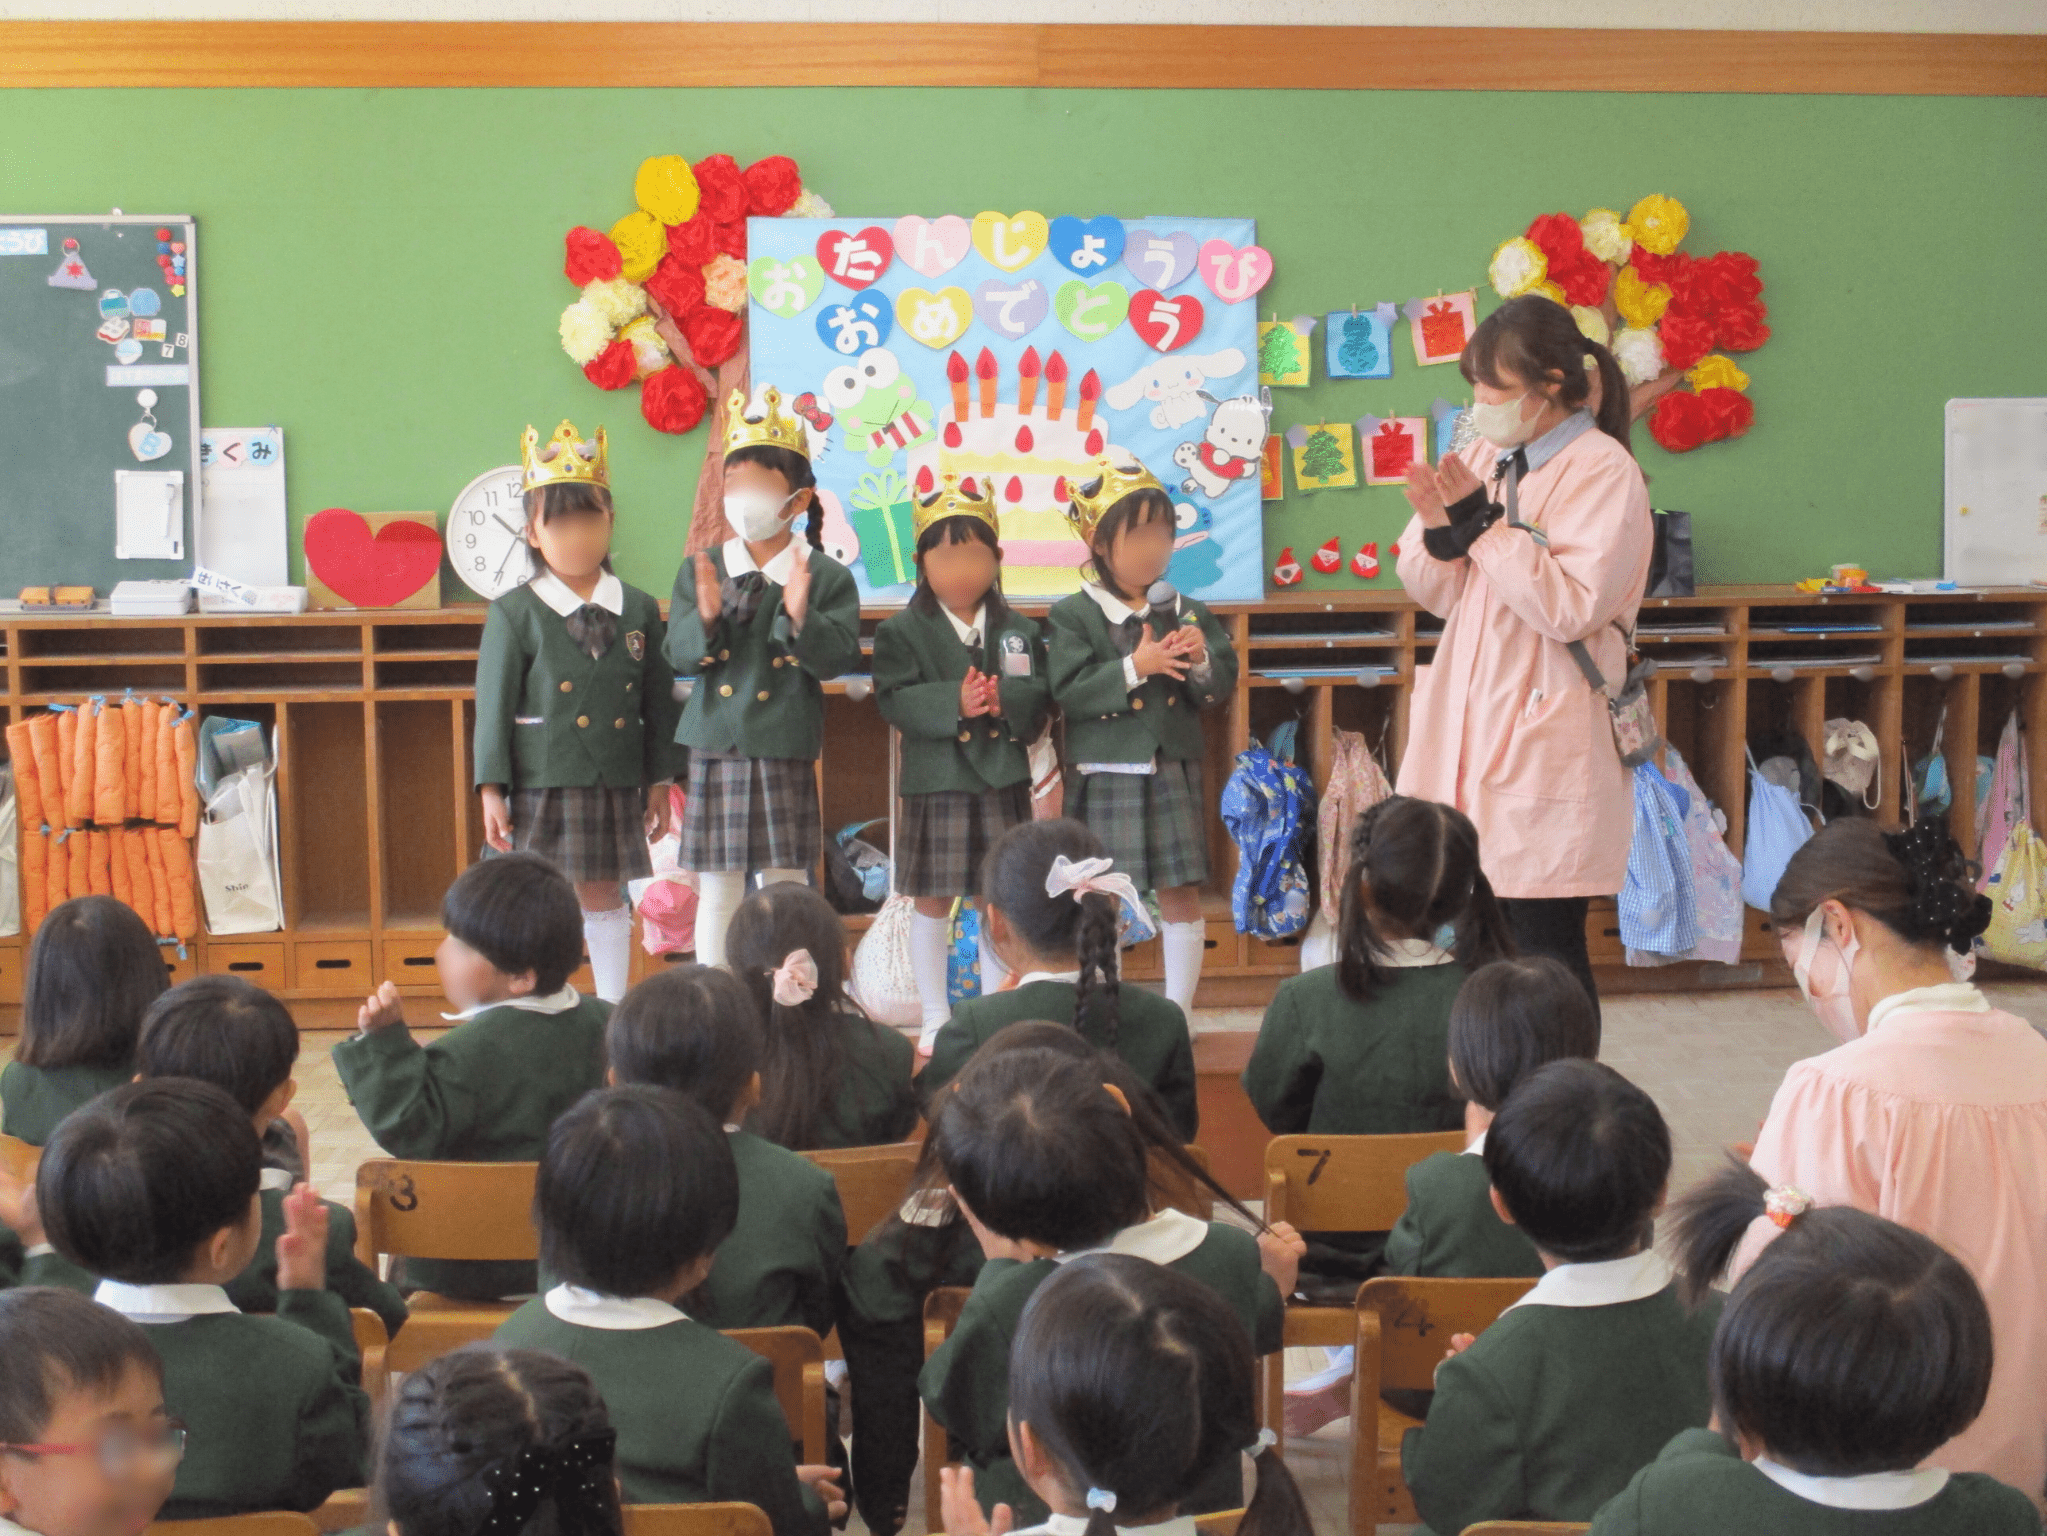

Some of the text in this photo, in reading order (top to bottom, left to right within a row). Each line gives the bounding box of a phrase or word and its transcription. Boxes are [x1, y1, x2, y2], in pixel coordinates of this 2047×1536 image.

[761, 219, 1259, 313] おたんじょうび
[827, 279, 1184, 354] おめでとう
[178, 335, 187, 346] 8
[164, 345, 172, 356] 7
[506, 482, 523, 498] 12
[485, 491, 498, 507] 11
[469, 510, 485, 526] 10
[465, 533, 477, 549] 9
[474, 556, 486, 571] 8
[493, 571, 504, 586] 7
[1297, 1149, 1331, 1186] 7
[389, 1174, 418, 1211] 3
